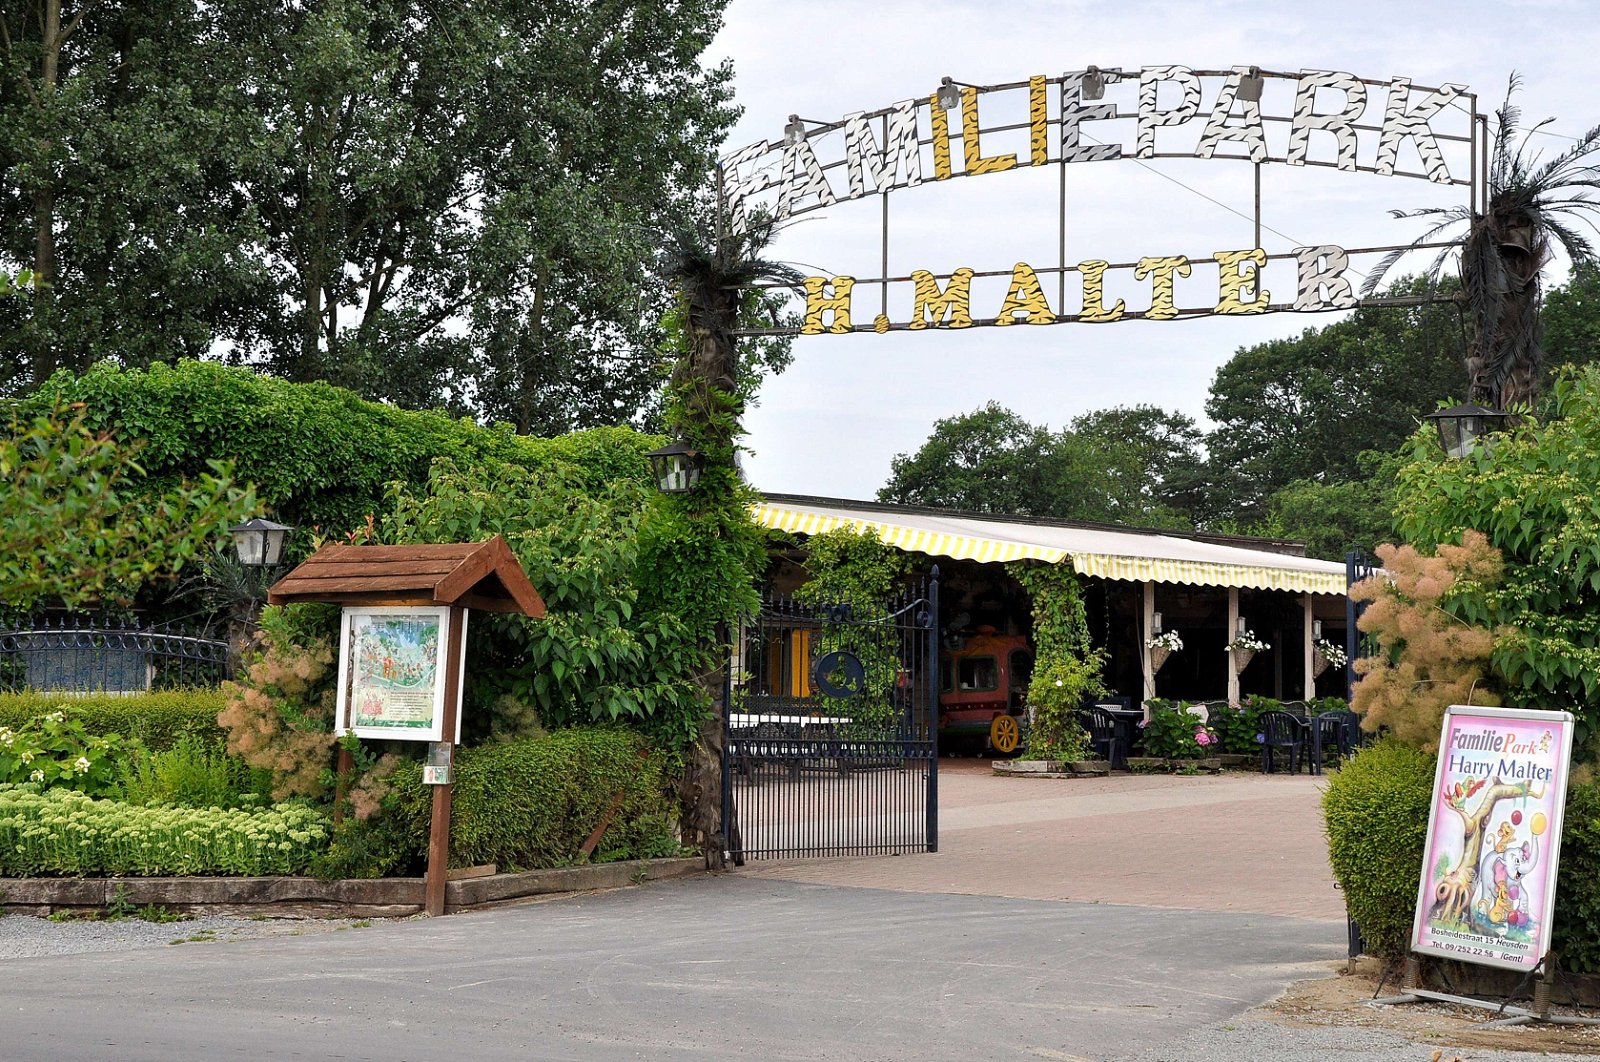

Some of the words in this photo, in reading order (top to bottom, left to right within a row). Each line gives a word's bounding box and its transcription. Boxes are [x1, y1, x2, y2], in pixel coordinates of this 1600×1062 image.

[1449, 755, 1494, 779] Harry
[1497, 758, 1552, 781] Malter
[1431, 927, 1483, 943] Bosheidestraat
[1485, 936, 1494, 945] 15
[1496, 938, 1529, 951] Heusden
[1445, 943, 1471, 954] 09/252
[1501, 951, 1524, 963] (Gent)
